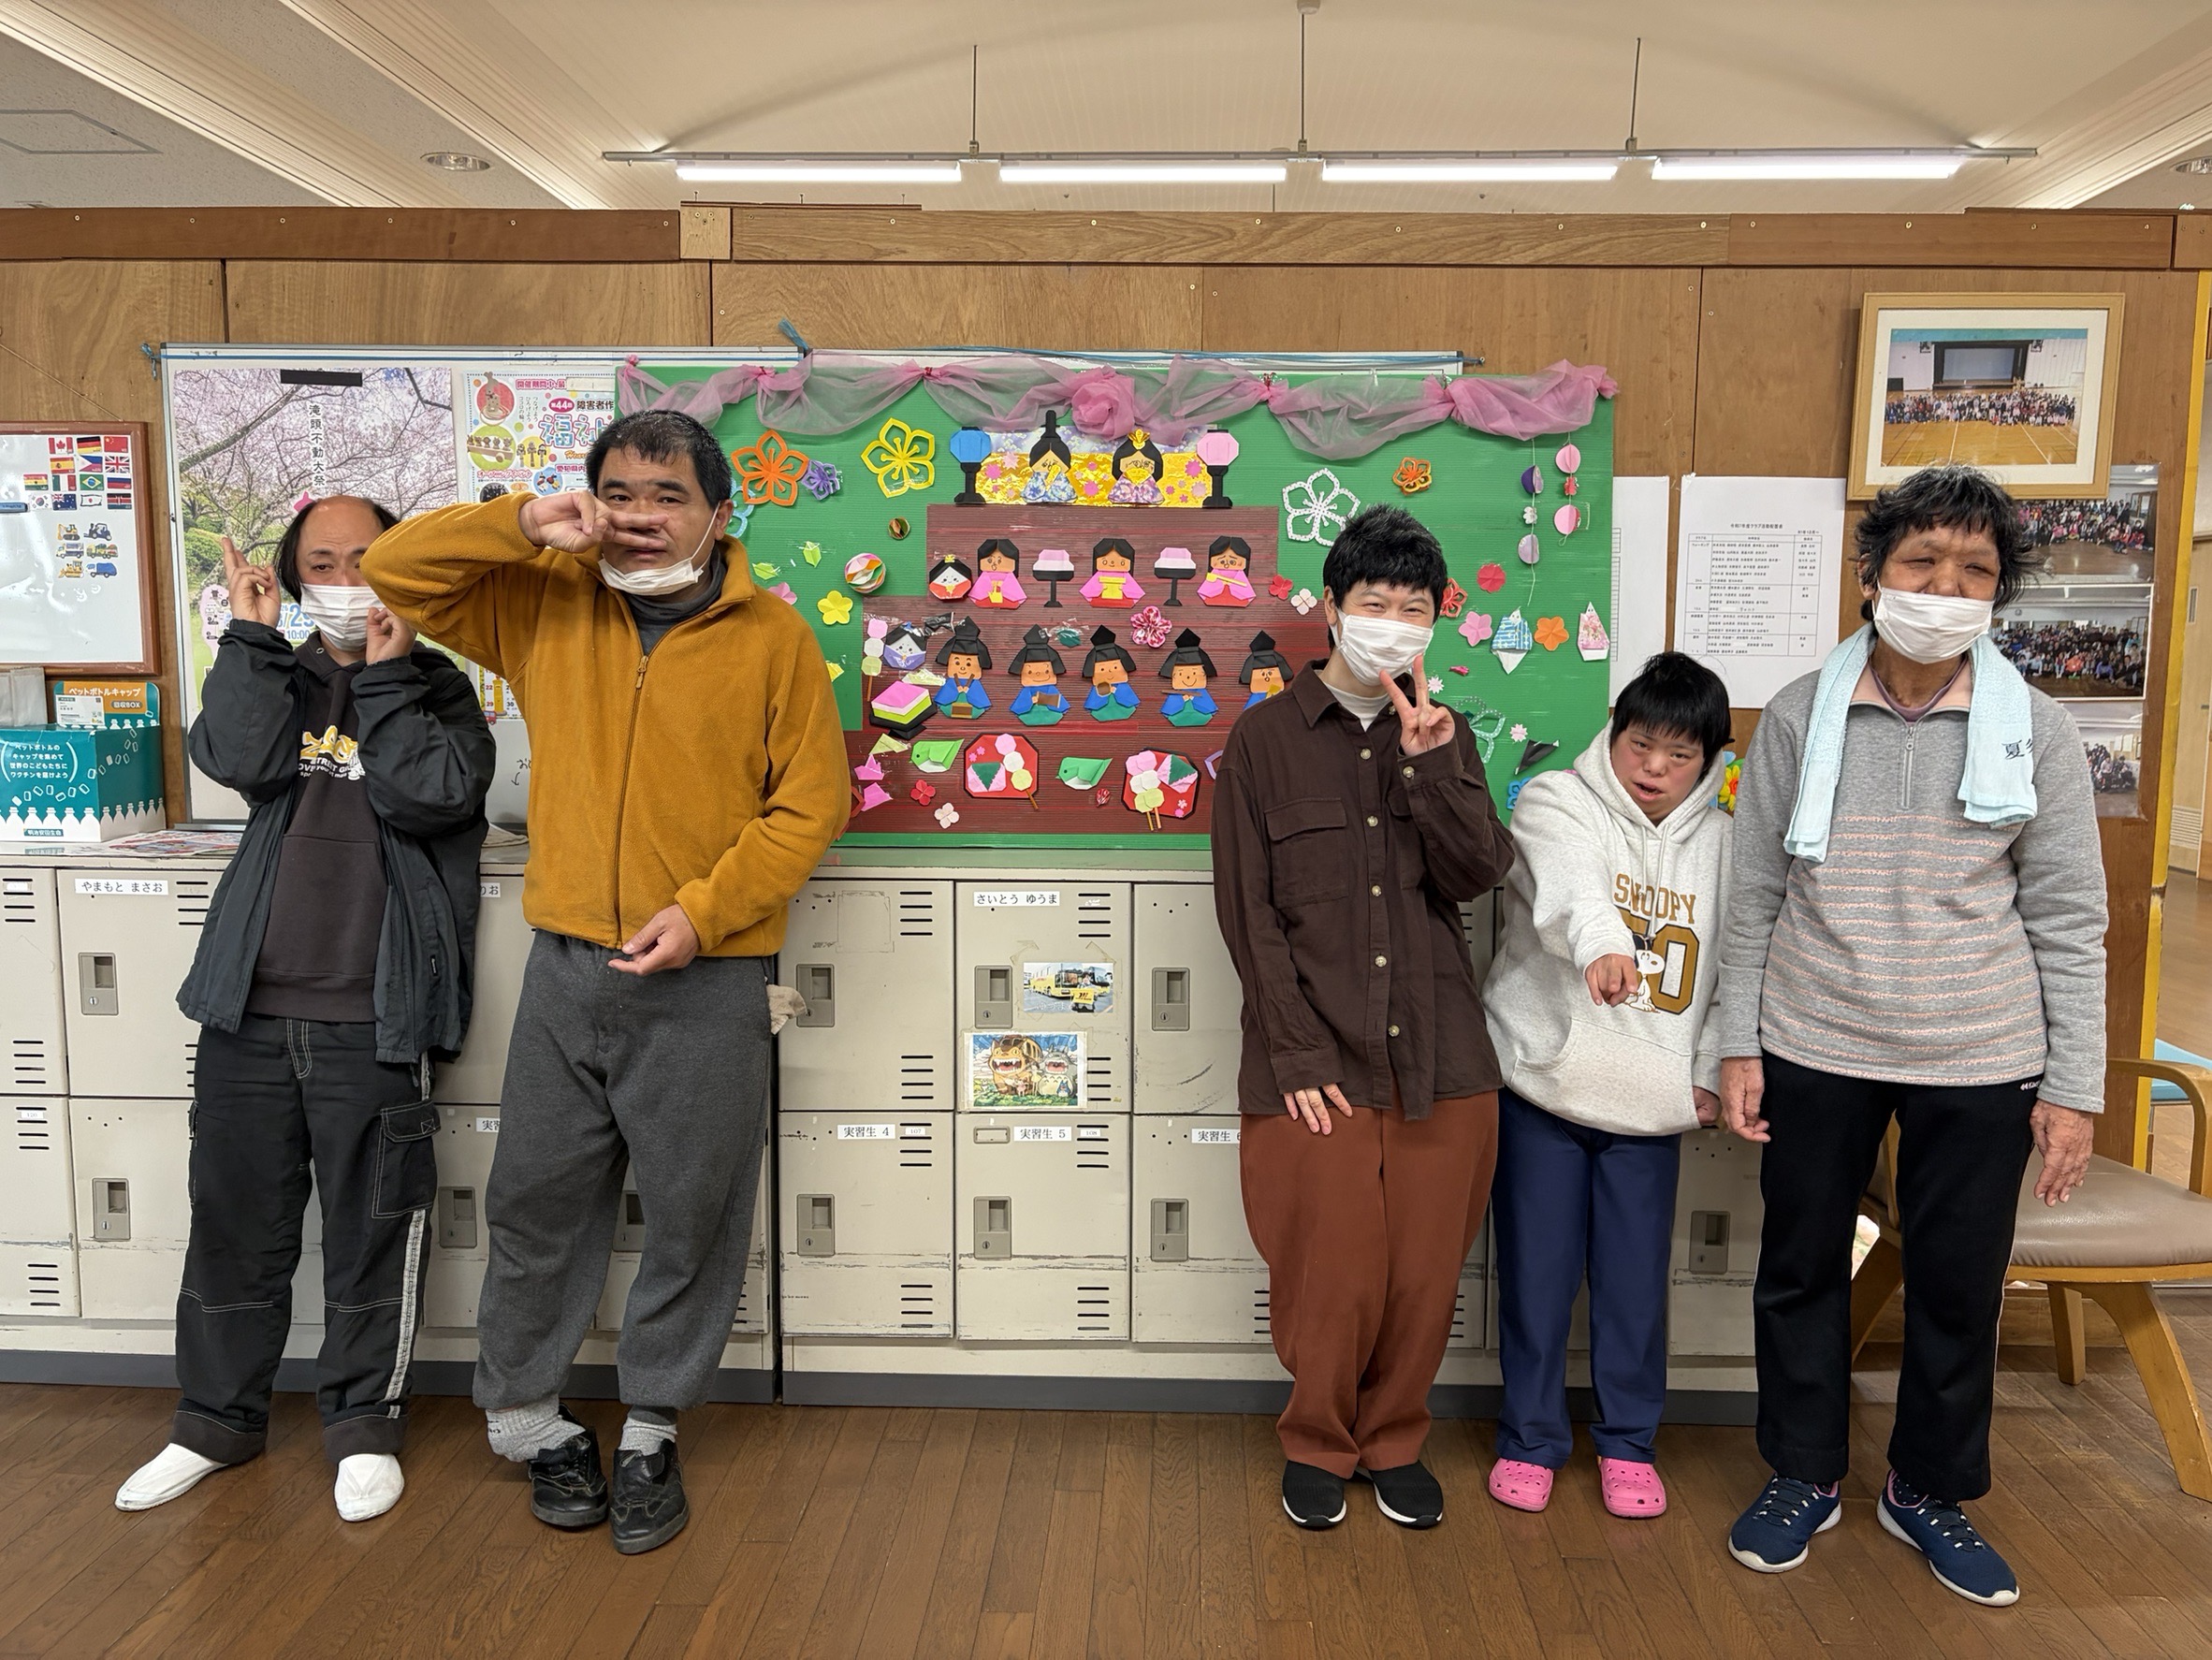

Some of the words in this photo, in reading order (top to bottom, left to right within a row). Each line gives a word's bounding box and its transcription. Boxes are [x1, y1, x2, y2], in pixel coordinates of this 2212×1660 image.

[576, 400, 614, 411] 障害者作
[309, 404, 326, 486] 滝頭不動大祭
[68, 687, 141, 697] ペットボトルキャップ
[113, 701, 140, 709] 回収BOX
[12, 752, 64, 761] キャップを集めて
[9, 762, 68, 770] 世界のこどもたちに
[27, 828, 63, 837] 明治安田生命
[81, 881, 124, 893] やまもと
[131, 881, 163, 893] まさお
[976, 894, 1019, 905] さいとう
[1026, 894, 1057, 905] ゆうま
[1613, 872, 1696, 925] SNOOPY
[843, 1126, 877, 1138] 実習生
[881, 1127, 889, 1136] 4
[1020, 1129, 1053, 1140] 実習生
[1058, 1129, 1066, 1139] 5
[1198, 1130, 1230, 1142] 実習生
